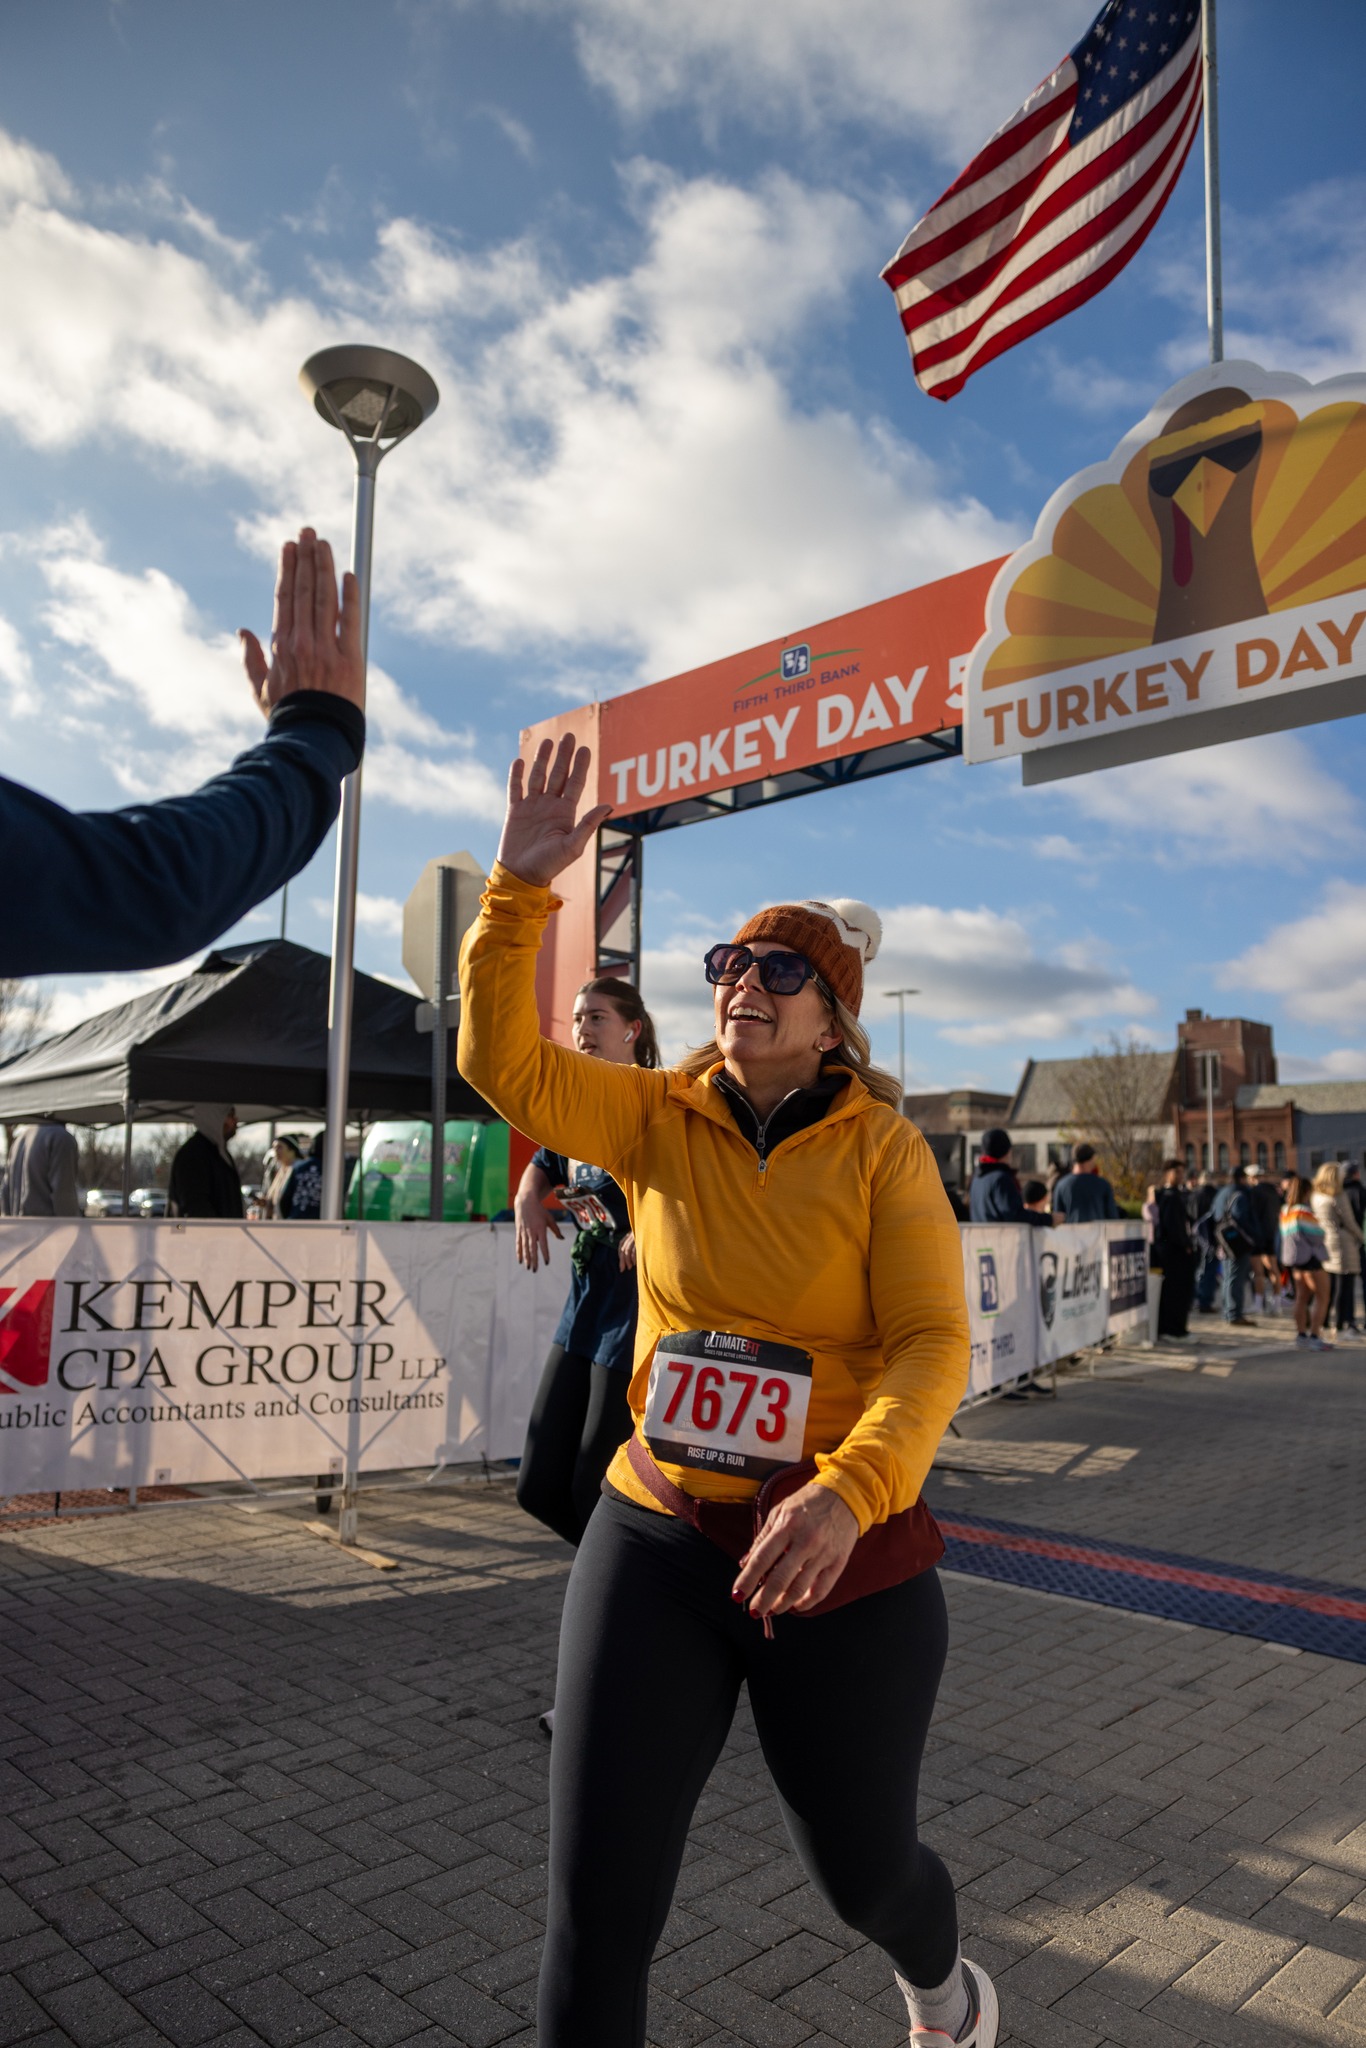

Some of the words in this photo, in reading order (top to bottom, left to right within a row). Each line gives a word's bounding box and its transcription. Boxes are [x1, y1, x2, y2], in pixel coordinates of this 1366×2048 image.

[733, 693, 768, 713] FIFTH
[774, 678, 816, 699] THIRD
[820, 663, 861, 685] BANK
[984, 650, 1215, 747] TURKEY
[1235, 611, 1366, 690] DAY
[610, 706, 800, 805] TURKEY
[817, 666, 929, 748] DAY
[60, 1279, 395, 1332] KEMPER
[57, 1347, 177, 1392] CPA
[196, 1342, 394, 1387] GROUP
[400, 1357, 447, 1380] LLP
[76, 1400, 245, 1426] Accountants
[254, 1394, 299, 1417] and
[310, 1389, 444, 1415] Consultants
[662, 1361, 790, 1443] 7673
[687, 1446, 706, 1459] RISE
[706, 1449, 718, 1461] UP
[718, 1452, 725, 1463] &
[726, 1453, 745, 1467] RUN
